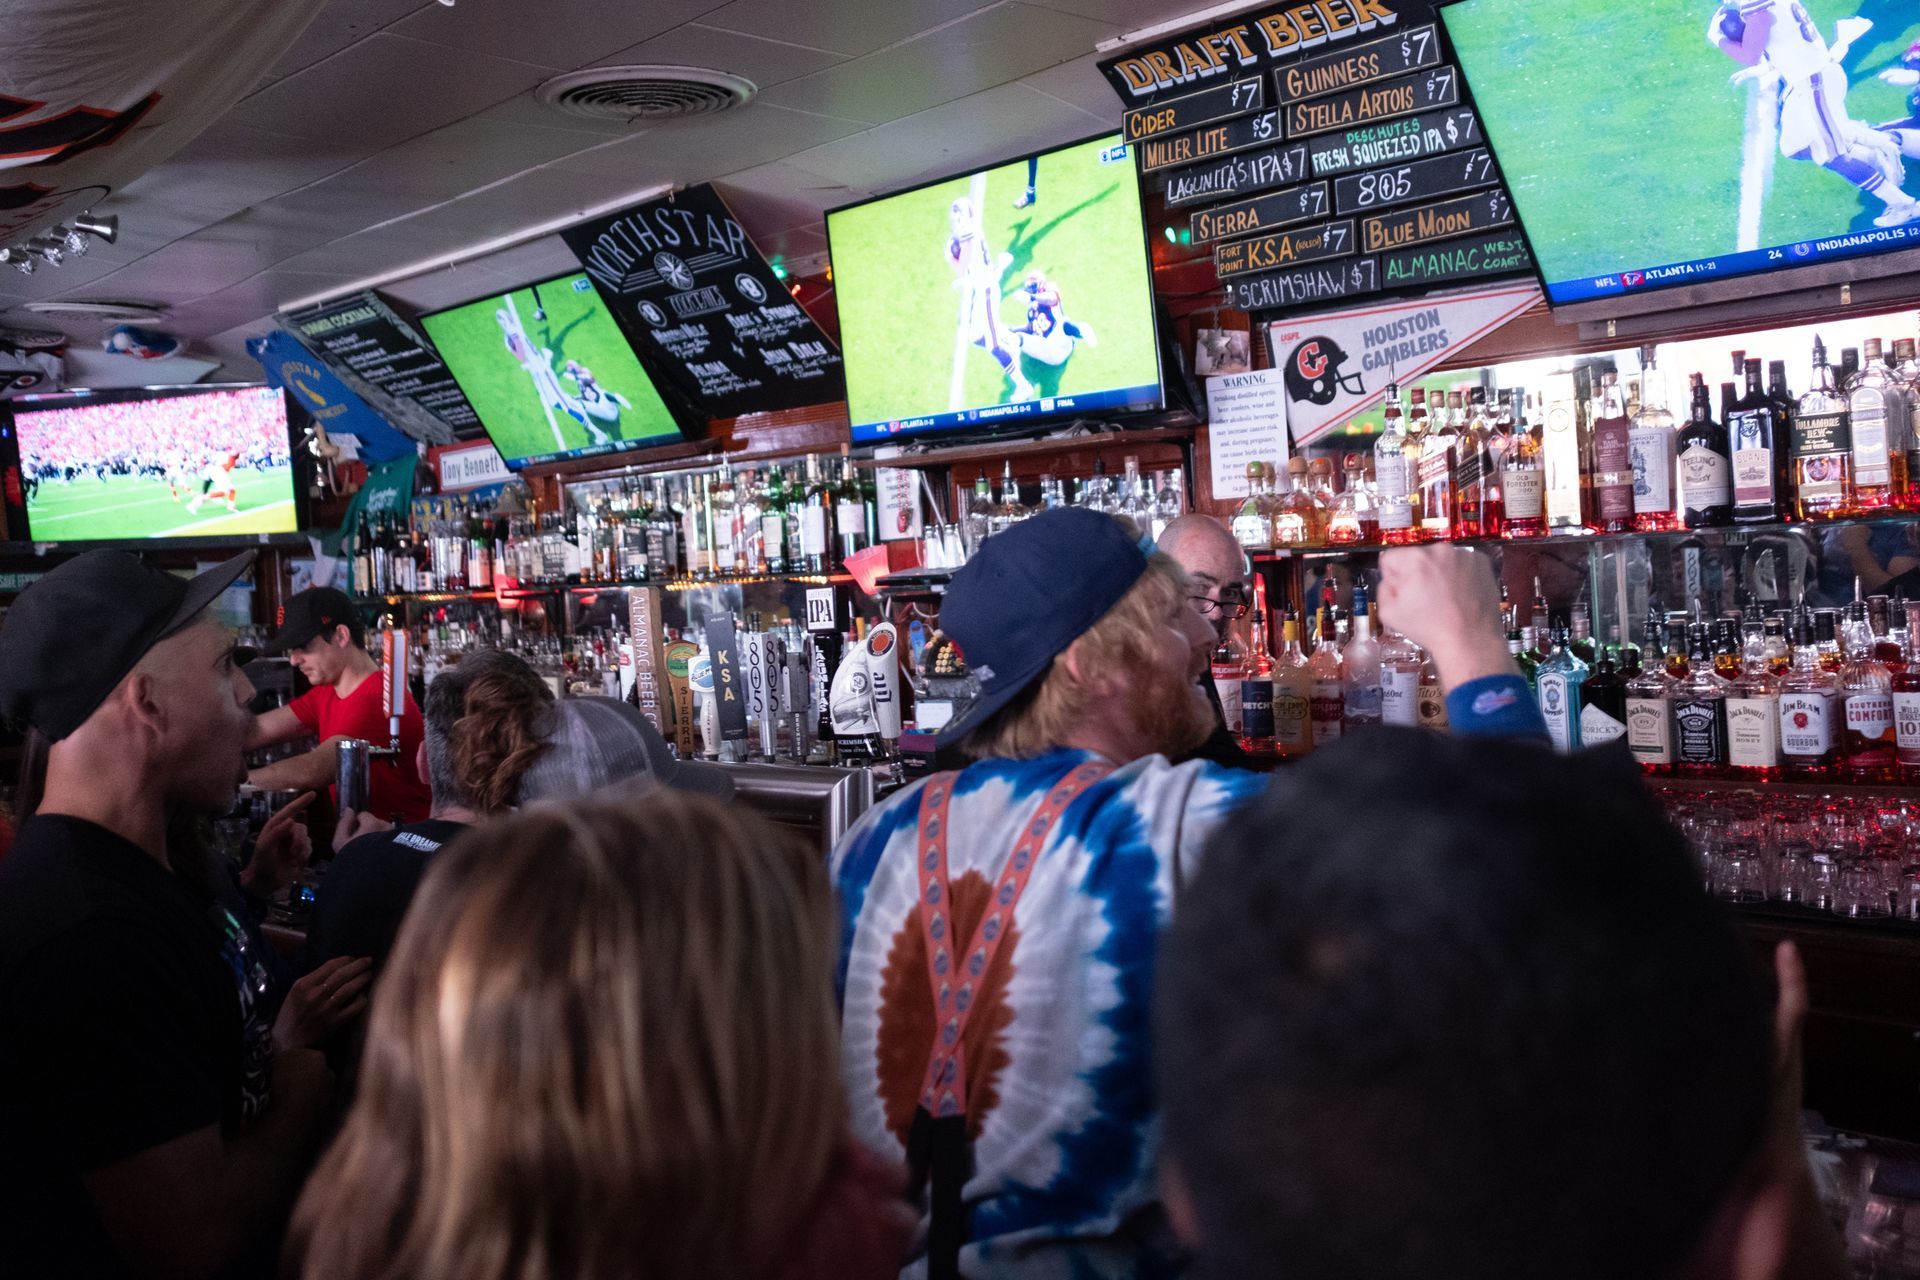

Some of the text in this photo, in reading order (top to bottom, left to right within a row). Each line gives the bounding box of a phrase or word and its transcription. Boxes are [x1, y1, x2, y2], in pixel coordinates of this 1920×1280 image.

[1114, 0, 1398, 96] DRAFT BEER
[1287, 31, 1430, 97] GUINNESS $7
[1130, 83, 1257, 138] CIDER $7
[1296, 72, 1451, 131] STELLA ARTOIS $7
[1147, 112, 1276, 168] MILLER LITE $5
[1346, 118, 1420, 144] DESCHUTES
[1112, 147, 1127, 159] NFL
[1311, 149, 1350, 173] FRESH
[1354, 133, 1421, 166] SQUEEZED
[1423, 127, 1446, 152] IPA
[1251, 155, 1284, 184] IPA
[1358, 168, 1411, 205] 805
[1200, 190, 1324, 239] SIERRA $7
[1323, 226, 1347, 251] $7
[1369, 220, 1415, 249] BLUE
[1418, 209, 1471, 239] MOON
[1220, 246, 1242, 258] FORT
[1768, 250, 1783, 260] 24
[1816, 228, 1905, 251] INDIANAPOLIS
[1219, 259, 1244, 273] POINT
[1387, 249, 1480, 280] ALMANAC
[1483, 239, 1523, 254] WEST
[1239, 259, 1374, 309] SCRIMSHAW $7
[1595, 277, 1617, 289] NFL
[1645, 264, 1694, 281] ATLANTA
[1362, 309, 1441, 349] HOUSTON
[1362, 329, 1450, 372] GAMBLERS
[1223, 373, 1266, 388] WARNING
[1057, 398, 1075, 408] FINAL
[1794, 416, 1840, 430] TULLAMORE
[443, 455, 499, 483] Tony Bennett
[1682, 456, 1716, 468] TEELING
[1736, 452, 1766, 464] SLANE
[1506, 480, 1538, 488] FORESTER
[808, 598, 833, 623] IPA
[632, 595, 650, 667] ALMANAC
[639, 672, 656, 708] BEER
[749, 641, 763, 713] 805
[766, 640, 779, 712] 805
[815, 645, 830, 713] LAGUNITAS
[873, 672, 892, 703] Lite
[1418, 687, 1442, 698] Tito's
[679, 687, 691, 745] SIERRA
[1628, 707, 1639, 718] JACK
[1676, 708, 1691, 719] JACK
[1729, 708, 1742, 719] JACK
[1782, 699, 1820, 716] JIM BEAM
[1848, 708, 1893, 722] COMFORT
[1900, 705, 1919, 714] WILD
[1899, 721, 1920, 735] 10
[1787, 738, 1819, 747] BOURBON
